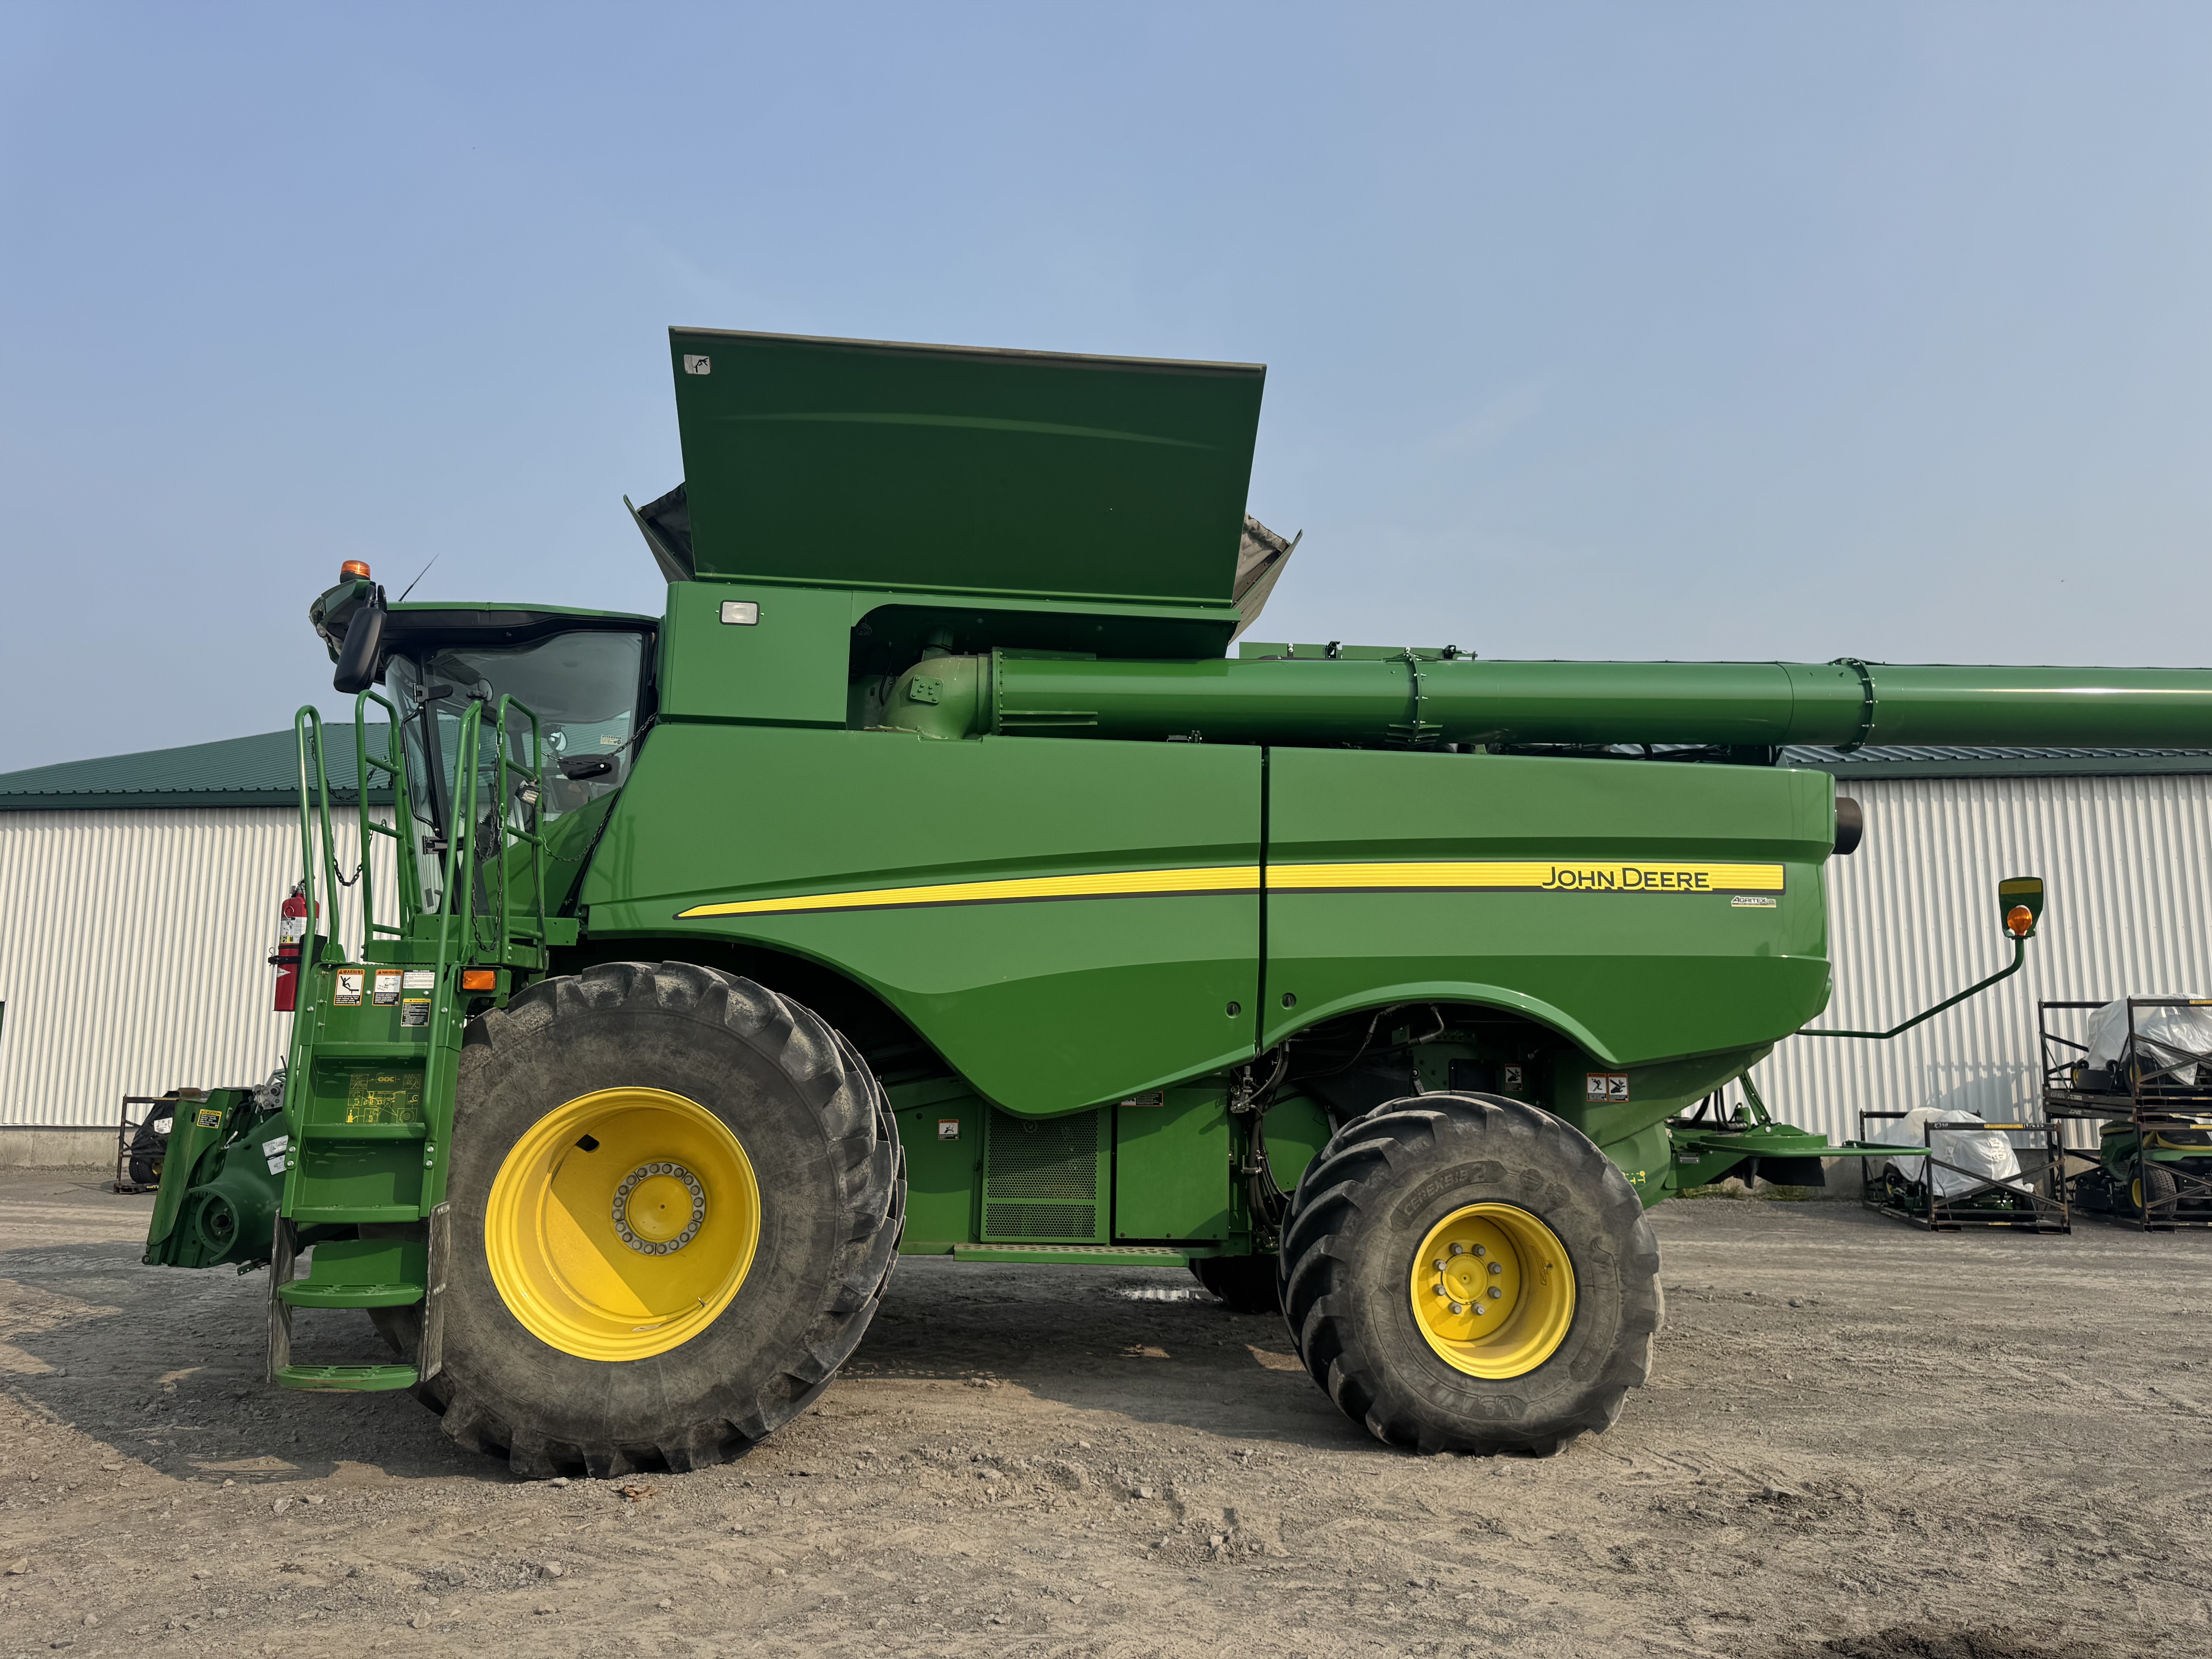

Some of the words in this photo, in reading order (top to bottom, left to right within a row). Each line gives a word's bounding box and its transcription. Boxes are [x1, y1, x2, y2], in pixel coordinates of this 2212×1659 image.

[1542, 866, 1614, 887] JOHN
[1622, 867, 1710, 888] DEERE
[1471, 1163, 1486, 1183] 2
